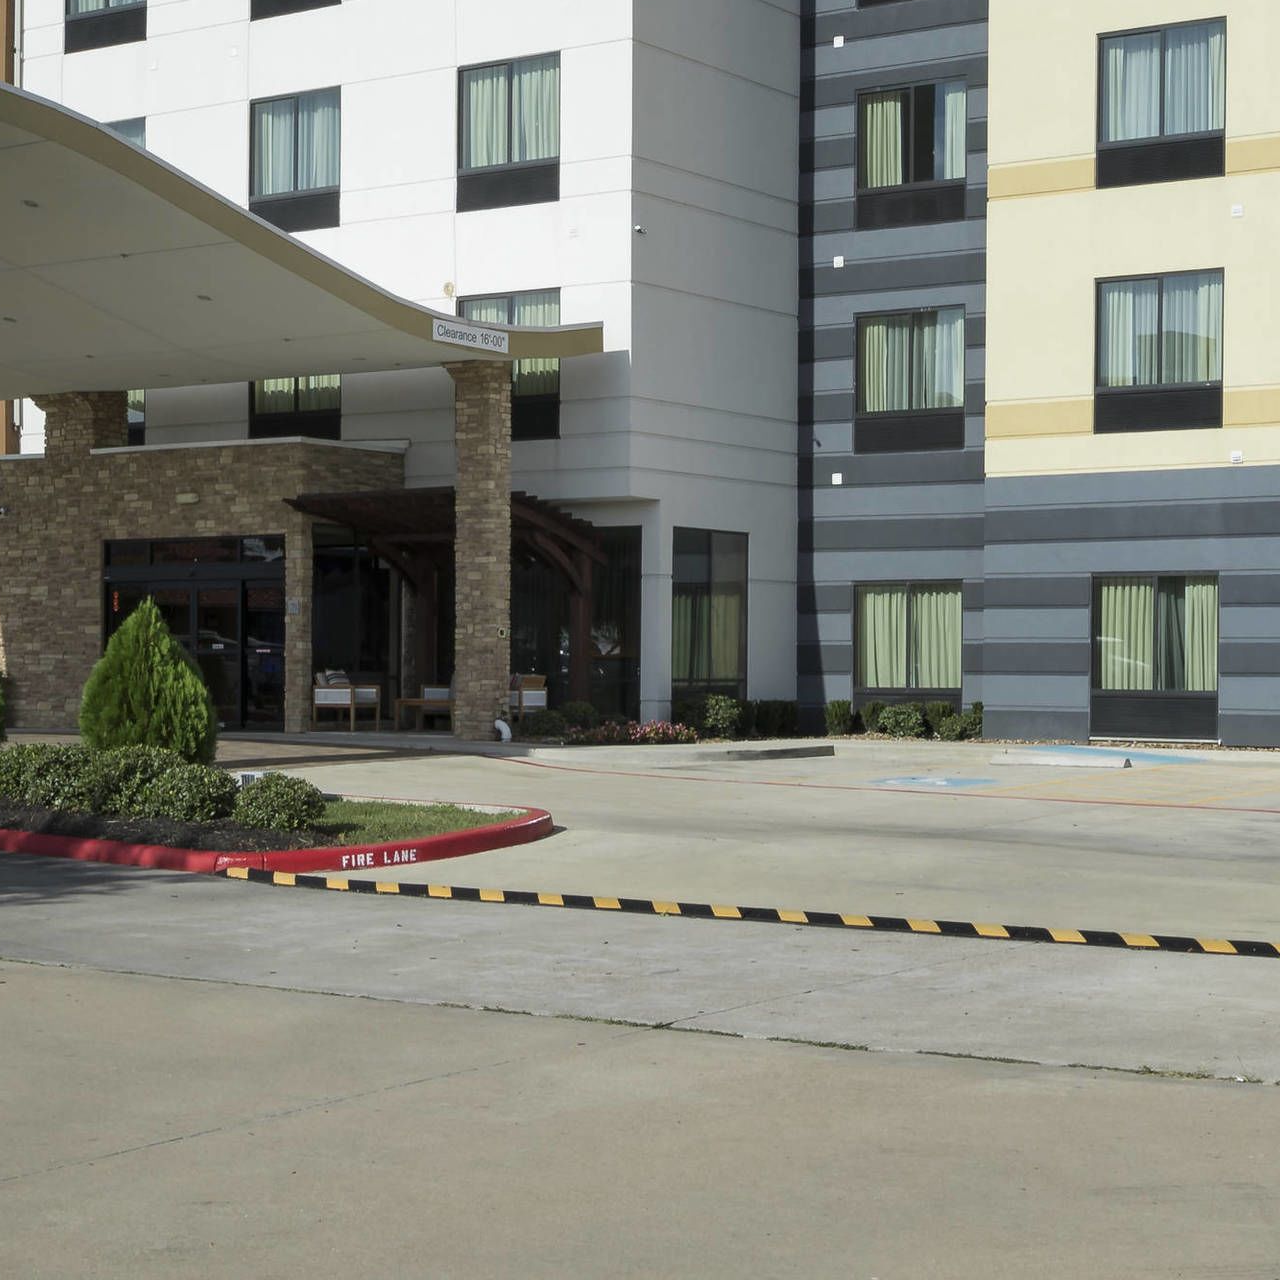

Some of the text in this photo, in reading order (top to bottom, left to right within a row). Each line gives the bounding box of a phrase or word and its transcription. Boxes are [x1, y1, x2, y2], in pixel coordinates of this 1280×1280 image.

[436, 324, 477, 343] Clearance
[342, 848, 417, 868] FIRE LANE
